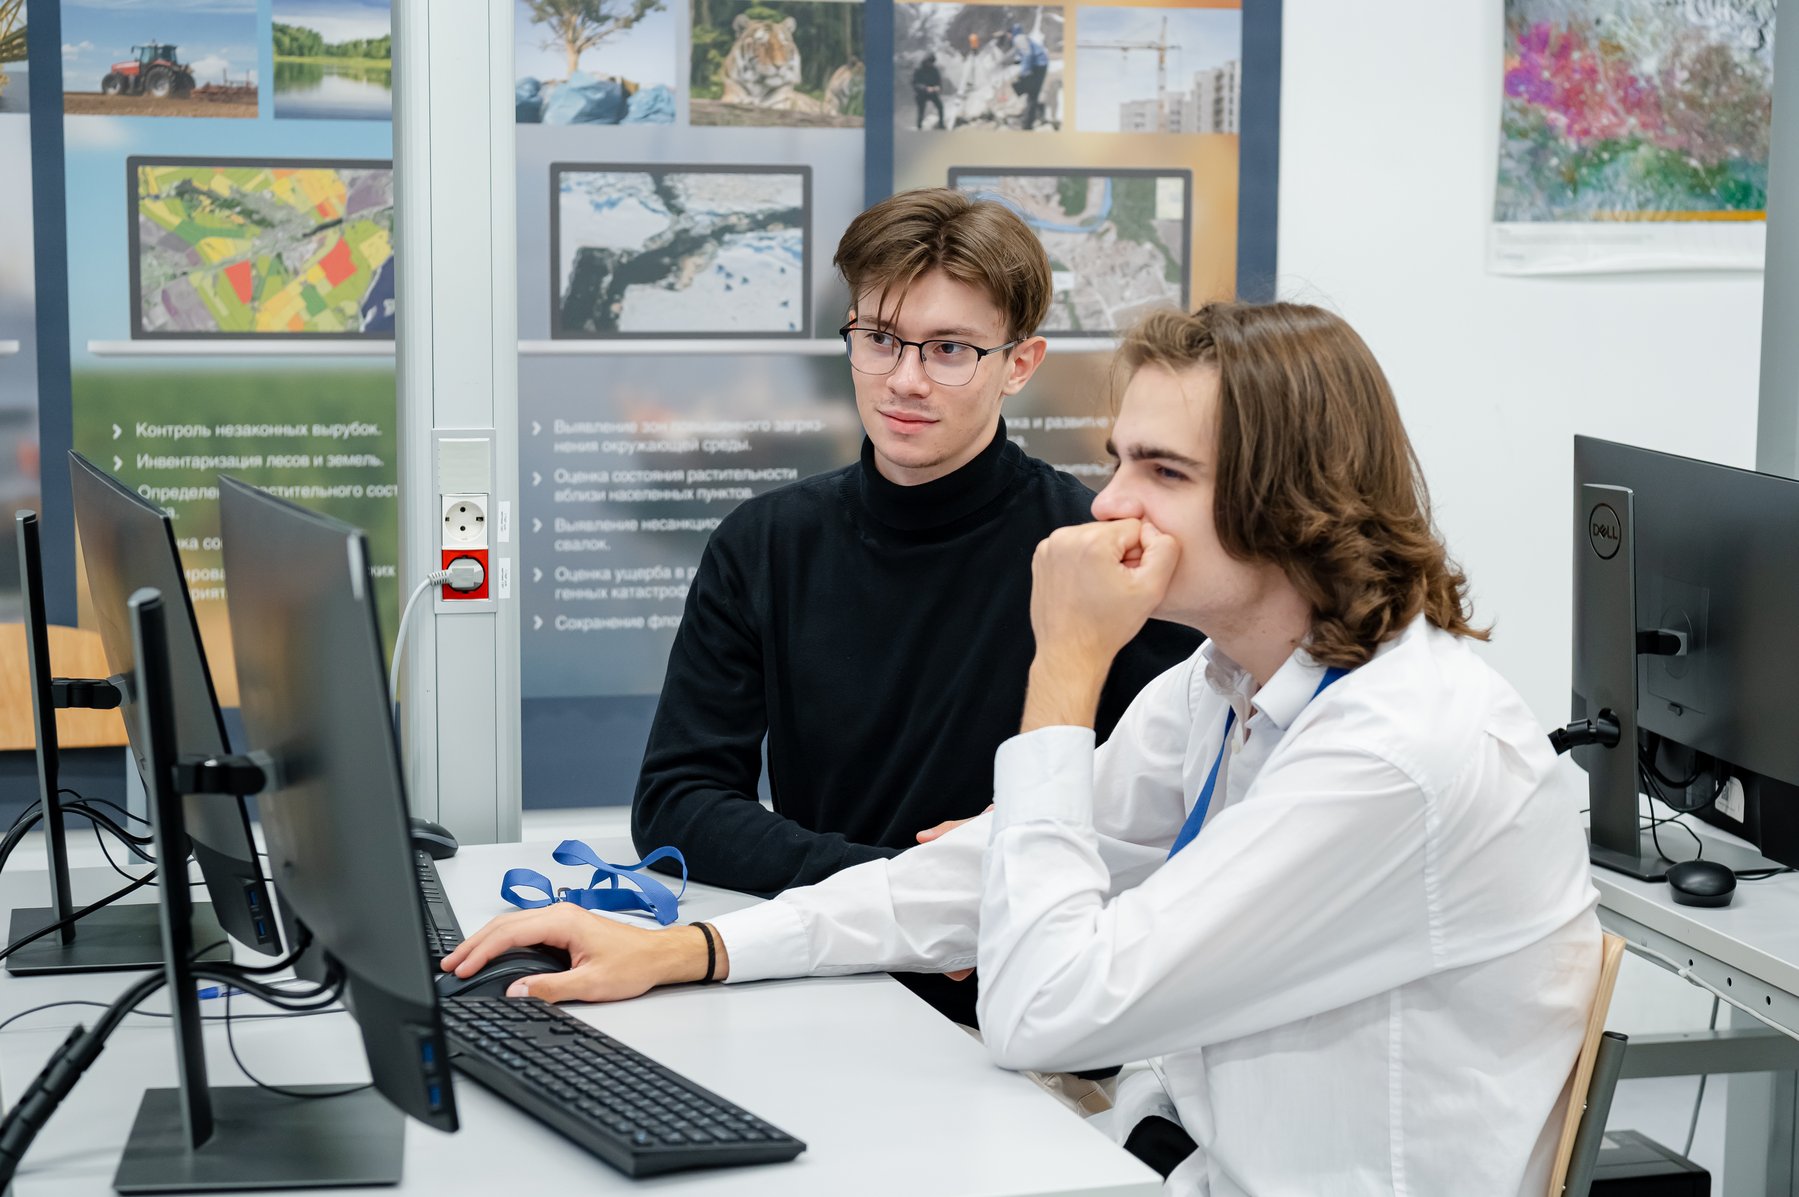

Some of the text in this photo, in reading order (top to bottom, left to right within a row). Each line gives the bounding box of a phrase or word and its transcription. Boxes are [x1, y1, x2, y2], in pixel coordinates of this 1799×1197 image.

[136, 421, 382, 440] Контроль незаконных вырубок.
[554, 420, 637, 435] Выявление
[554, 438, 752, 454] нения окружающей среды.
[137, 453, 384, 470] Инвентаризация лесов и земель.
[554, 468, 798, 484] Оценка состояния растительности
[554, 487, 755, 503] вблизи населенных пунктов.
[554, 517, 721, 532] Выявление несанкцио
[1593, 524, 1618, 540] DELL
[554, 539, 611, 551] свалок.
[554, 566, 612, 582] Оценка
[614, 565, 672, 584] ущерба
[674, 567, 684, 579] в
[555, 587, 608, 600] генных
[555, 614, 682, 631] Сохранение фло
